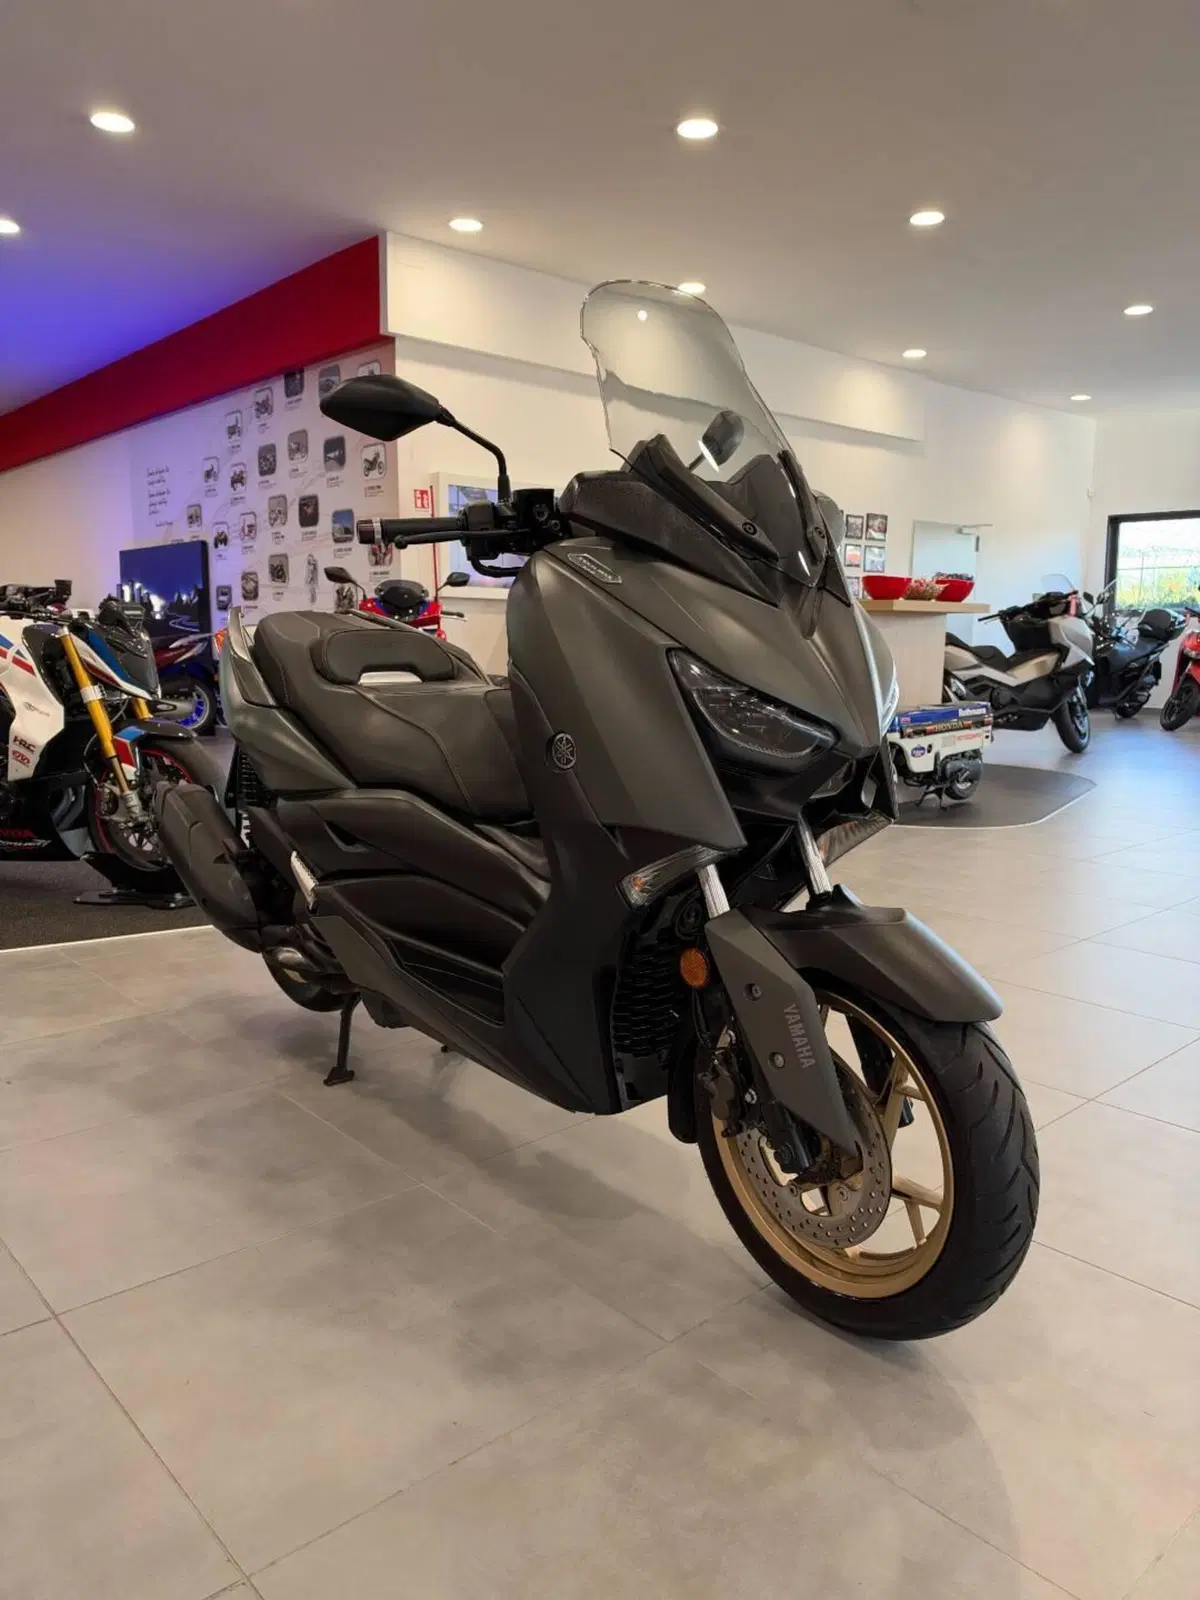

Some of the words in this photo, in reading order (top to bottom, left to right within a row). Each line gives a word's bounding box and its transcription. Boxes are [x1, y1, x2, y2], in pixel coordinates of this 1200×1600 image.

[935, 720, 964, 732] HONDA
[13, 735, 36, 753] HRC
[783, 1002, 816, 1069] YAMAHA
